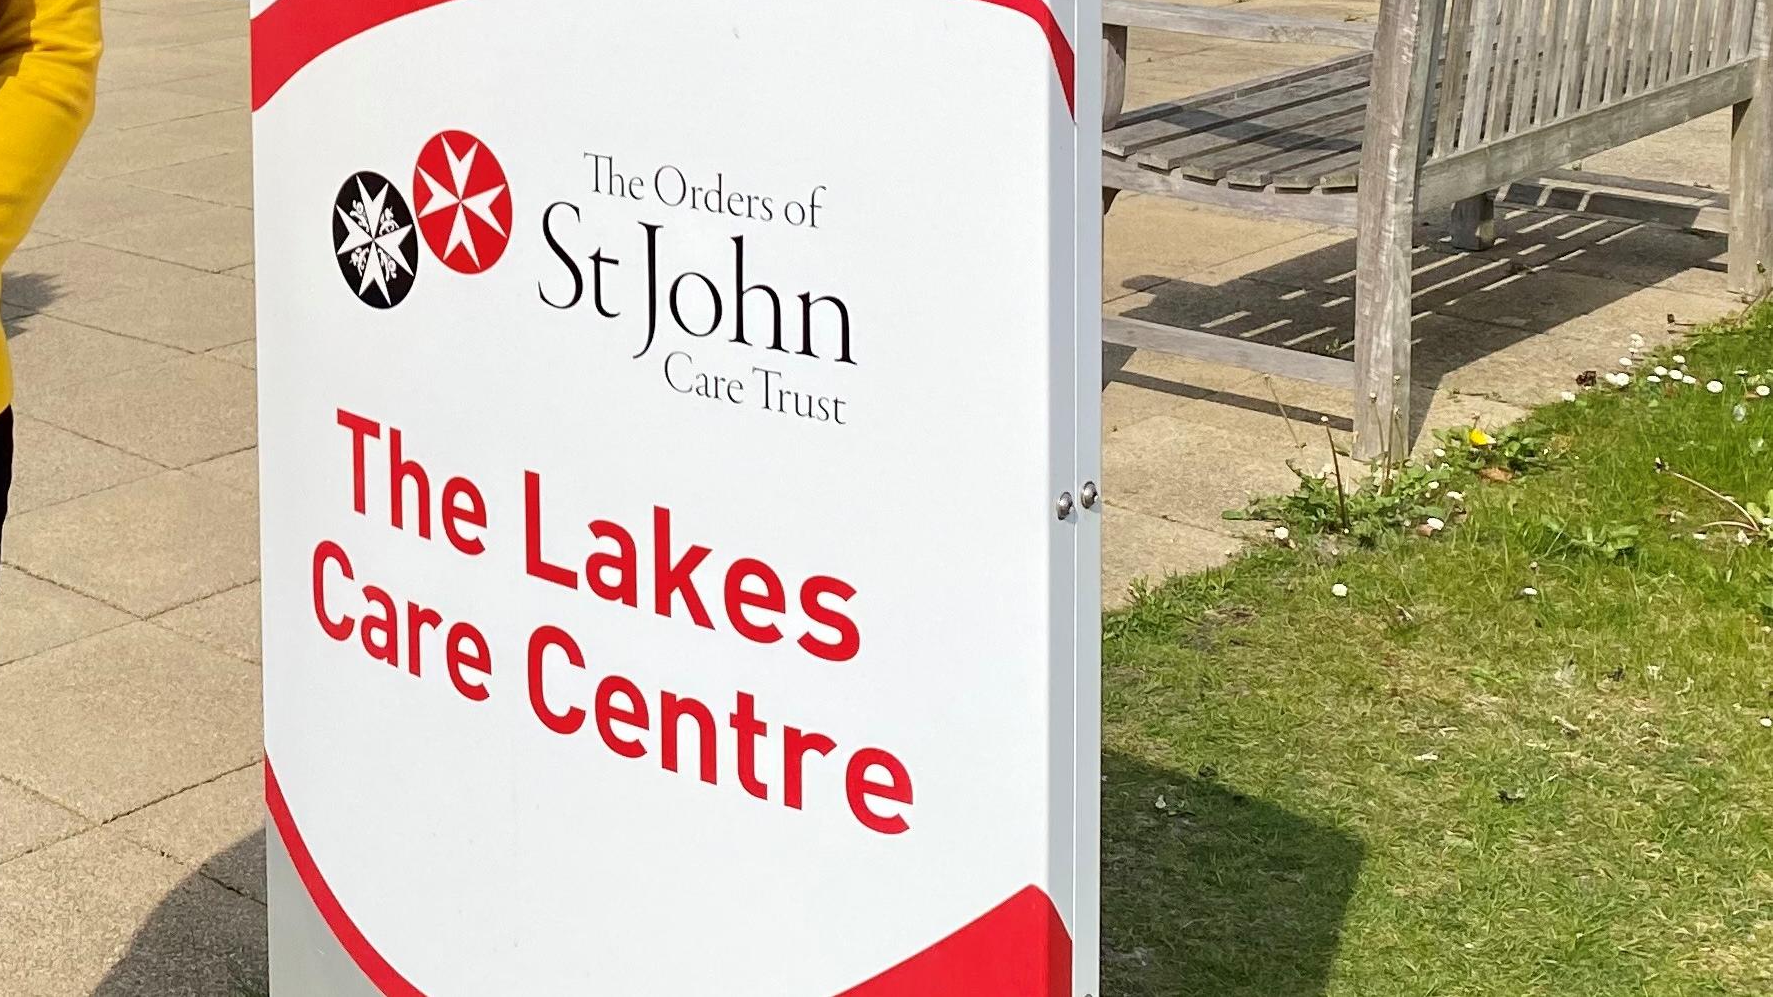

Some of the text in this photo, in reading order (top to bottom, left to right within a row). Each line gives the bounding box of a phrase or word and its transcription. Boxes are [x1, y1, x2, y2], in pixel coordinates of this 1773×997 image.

[582, 152, 827, 229] The Orders of
[537, 201, 858, 367] St John
[663, 350, 848, 426] Care Trust
[336, 409, 860, 662] The Lakes
[312, 540, 914, 835] Care Centre
